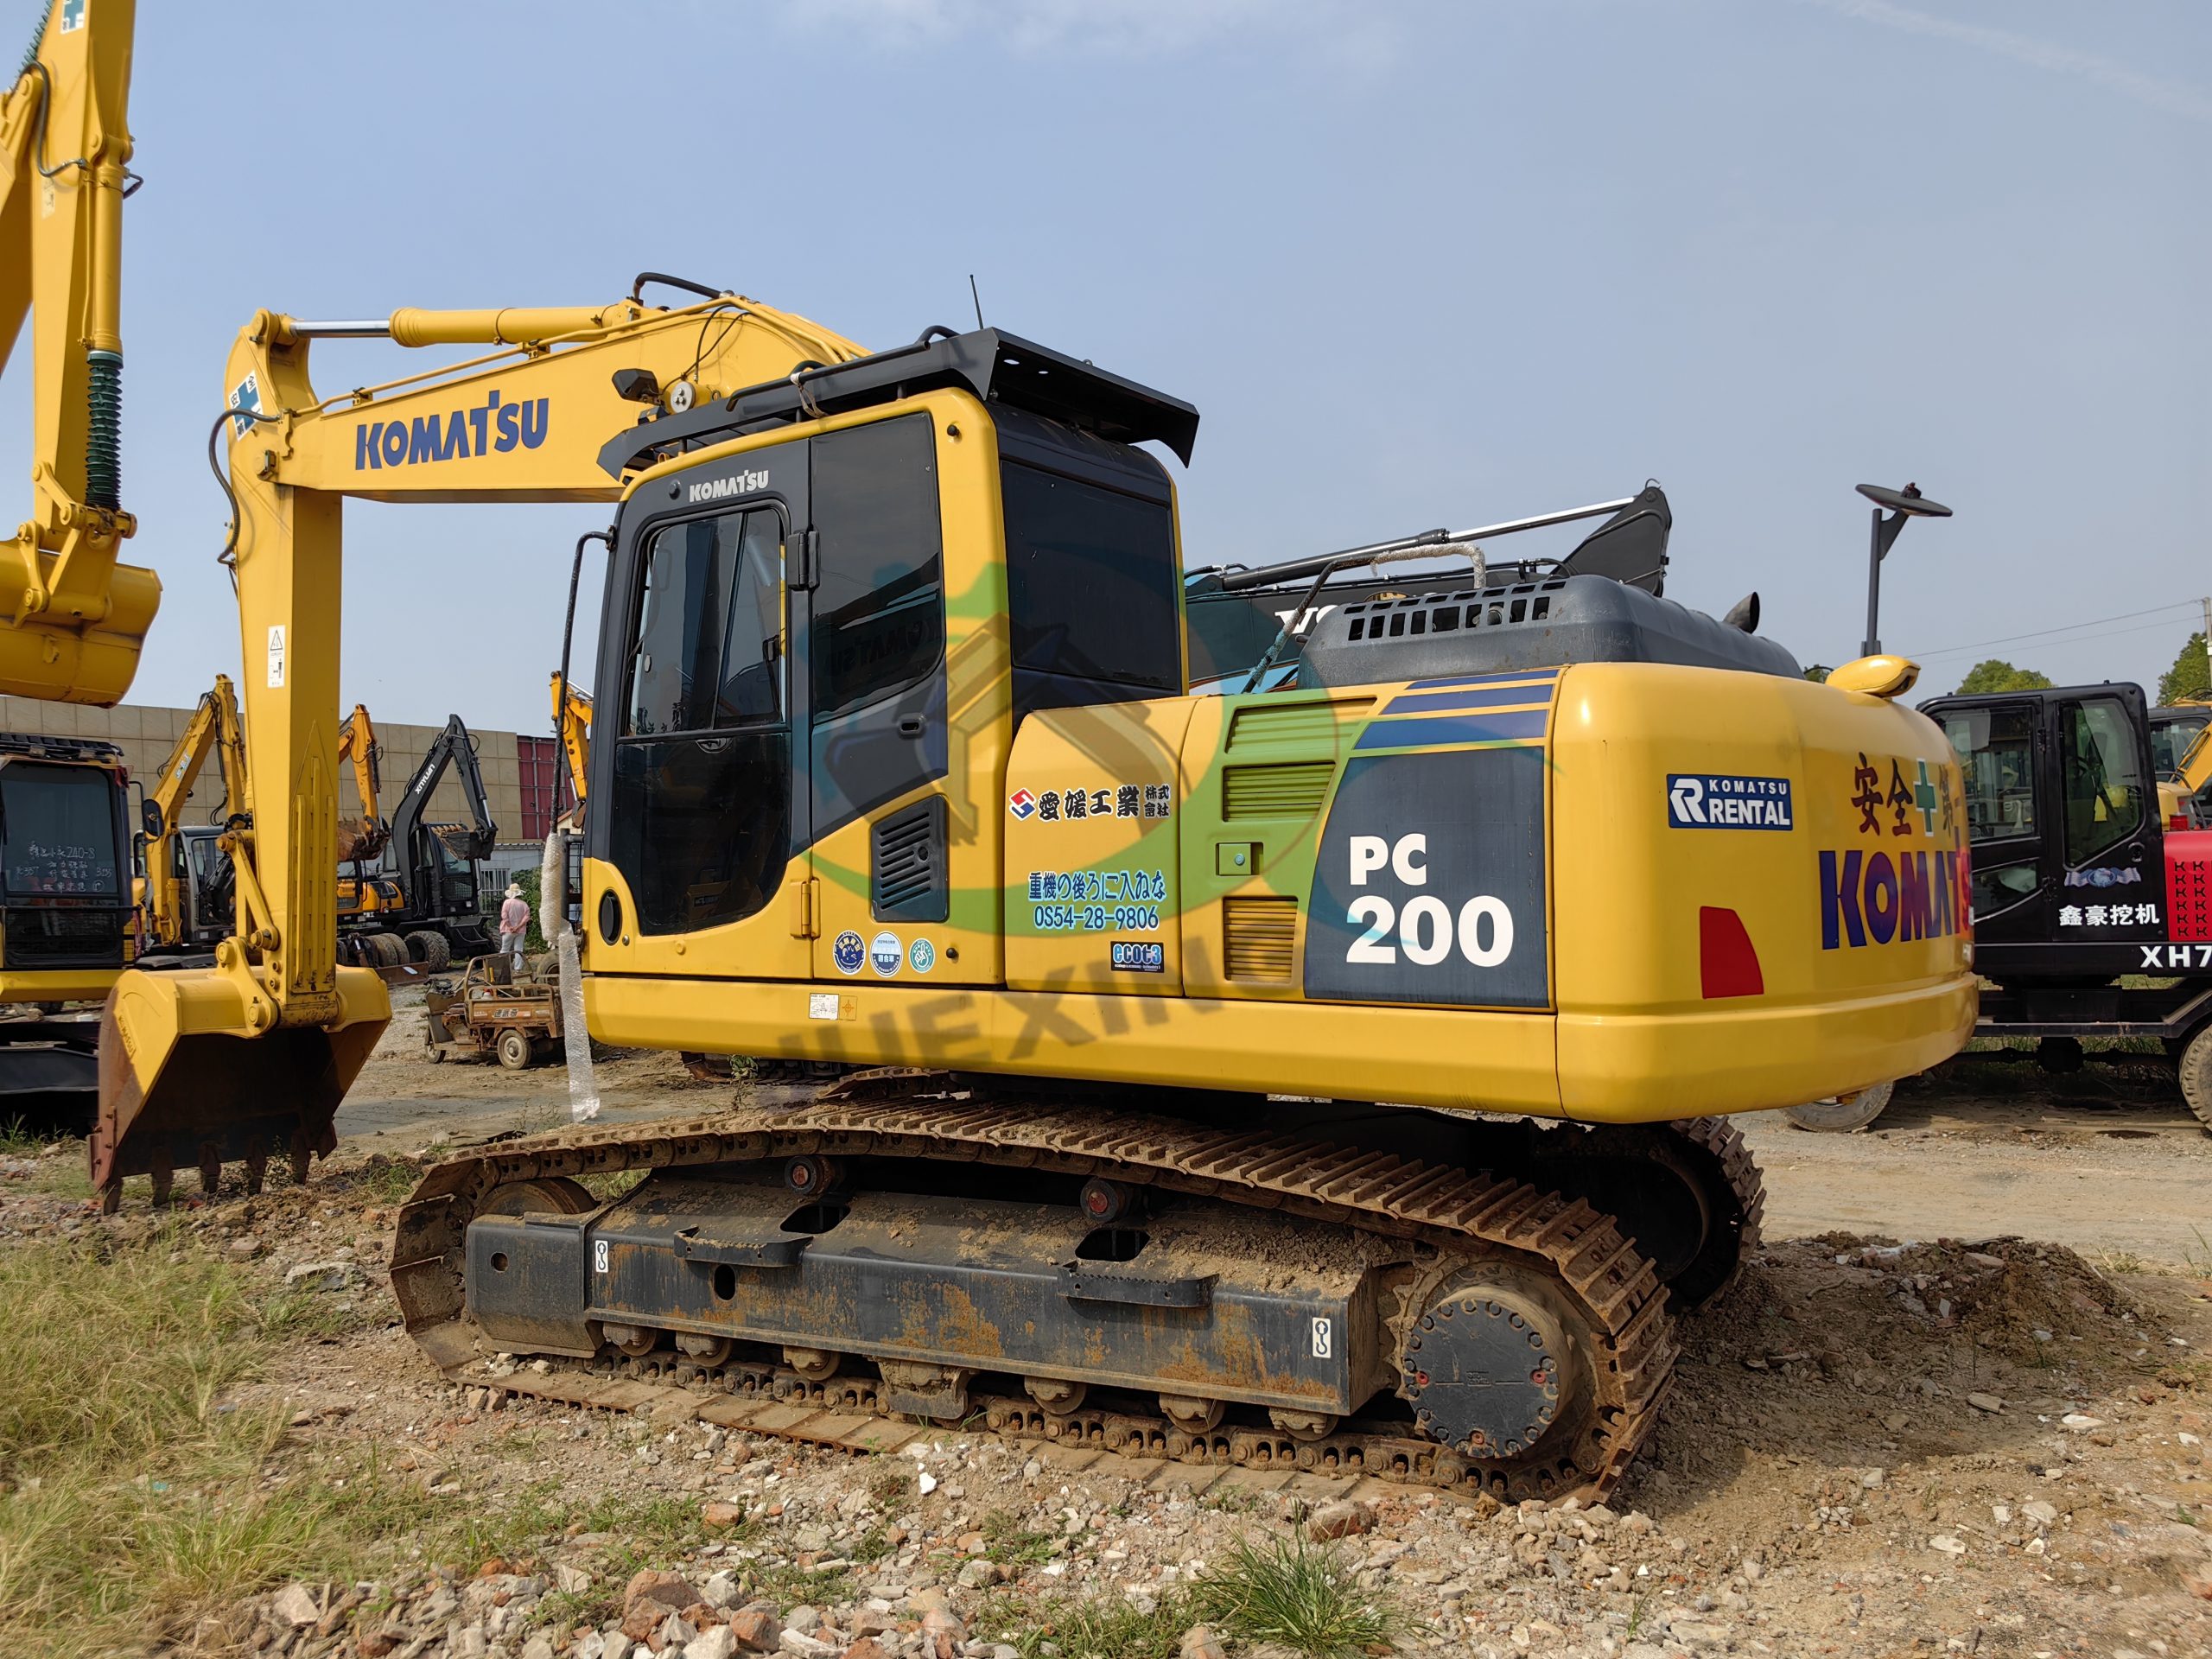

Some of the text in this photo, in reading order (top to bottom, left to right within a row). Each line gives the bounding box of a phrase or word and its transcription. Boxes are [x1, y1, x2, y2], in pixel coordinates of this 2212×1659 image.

[355, 390, 550, 471] KOMATSU
[689, 469, 769, 503] KOMATSU
[1708, 779, 1788, 795] KOMATSU
[1850, 751, 1913, 837] 安全
[1708, 798, 1791, 825] RENTAL
[1350, 833, 1427, 886] PC
[2058, 903, 2160, 926] 鑫豪挖机
[1345, 895, 1514, 968] 200
[1112, 943, 1162, 965] ecot3
[2139, 945, 2212, 969] XH7
